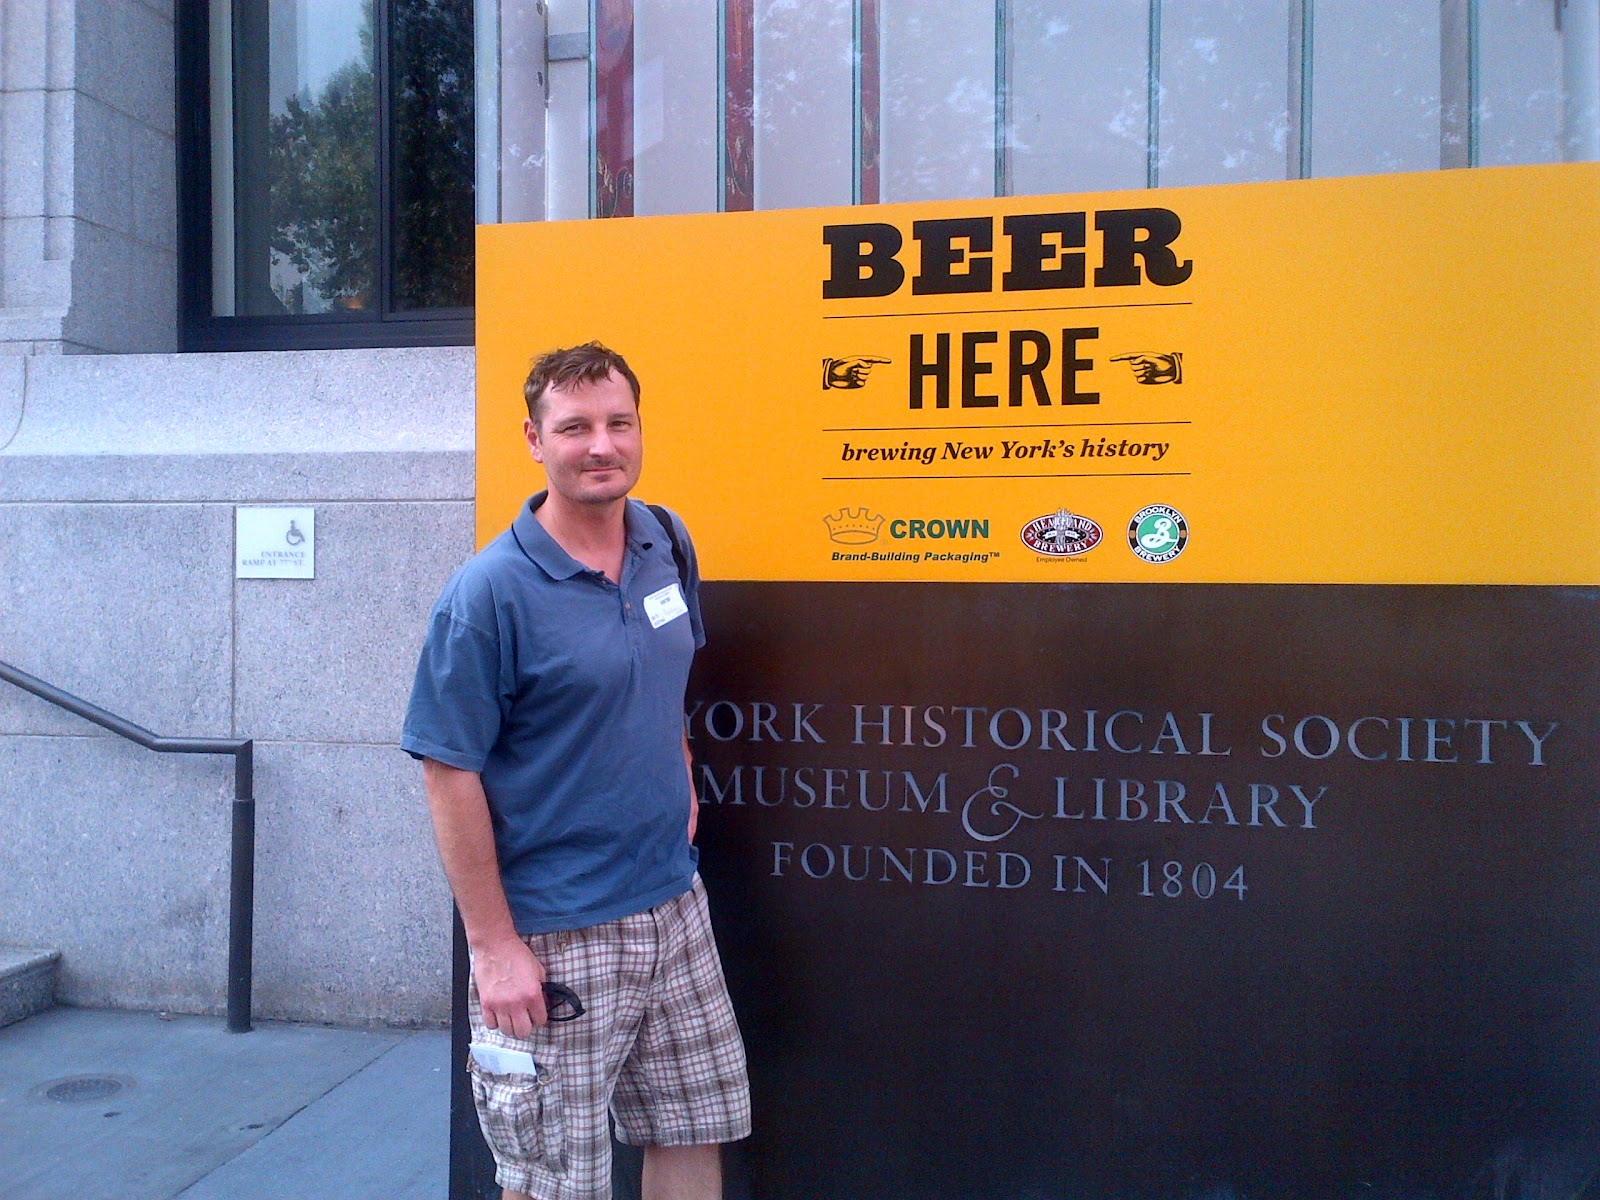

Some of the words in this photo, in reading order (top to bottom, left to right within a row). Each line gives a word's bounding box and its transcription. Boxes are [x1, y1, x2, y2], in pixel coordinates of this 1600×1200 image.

[822, 207, 1193, 299] BEER
[909, 327, 1100, 409] HERE
[842, 442, 937, 465] brewing
[941, 442, 994, 460] New
[1001, 439, 1074, 459] York's
[1080, 438, 1169, 461] history
[1133, 507, 1182, 523] BROOKLYN
[890, 519, 989, 539] CROWN
[831, 552, 920, 563] Brand-Building
[1033, 540, 1088, 553] BREWERY
[1133, 545, 1181, 561] BREWERY
[684, 701, 826, 744] YORK
[851, 704, 1231, 756] HISTORICAL
[1260, 714, 1559, 766] SOCIETY
[699, 764, 950, 813] MUSEUM
[961, 763, 1044, 841] &
[1052, 776, 1328, 828] LIBRARY
[770, 841, 1031, 889] FOUNDED
[1052, 854, 1112, 894] IN
[1137, 859, 1249, 900] 1804
